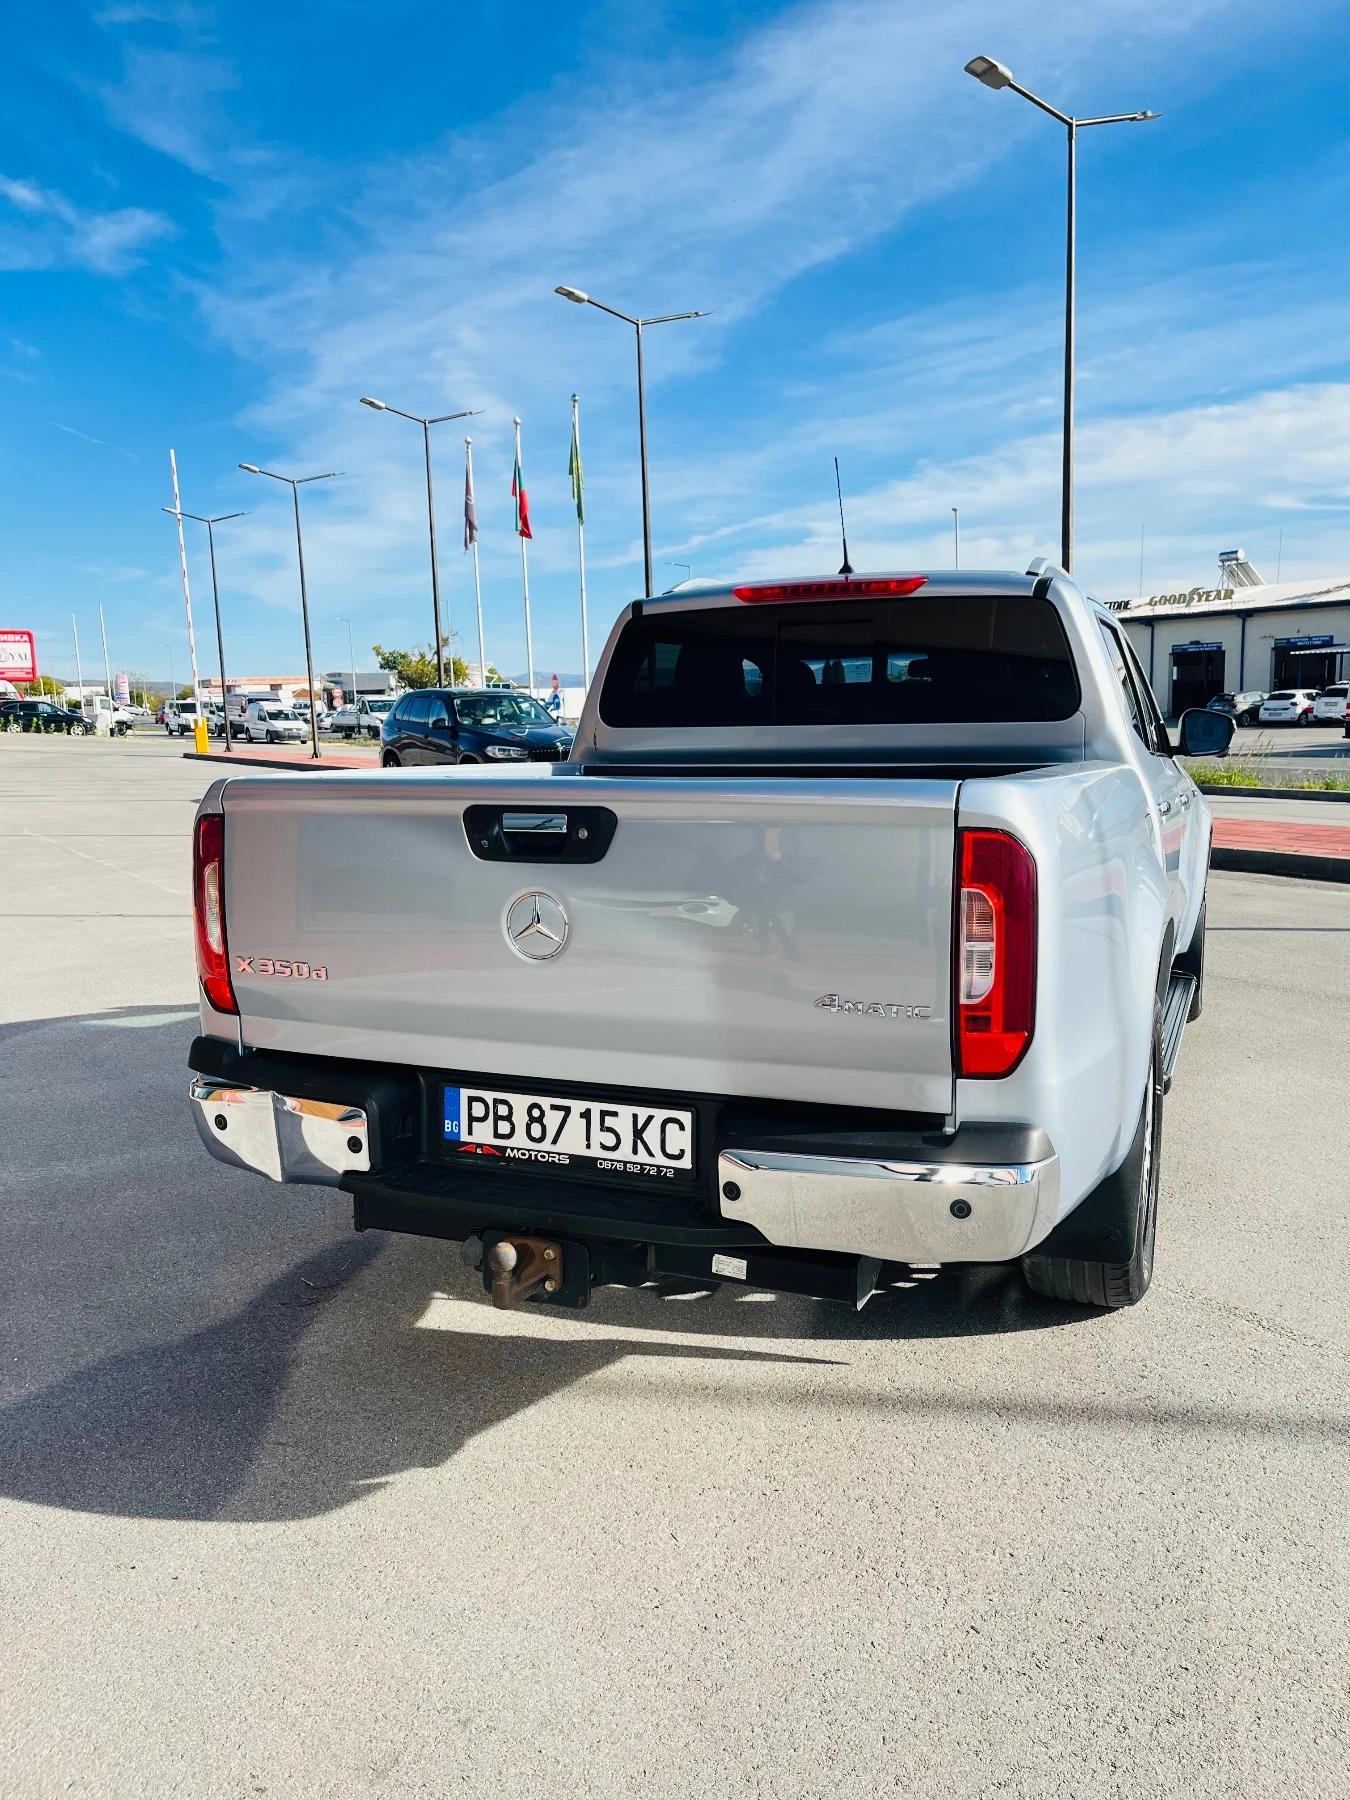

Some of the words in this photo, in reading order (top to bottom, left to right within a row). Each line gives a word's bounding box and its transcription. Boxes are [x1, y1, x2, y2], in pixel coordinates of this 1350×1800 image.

[1148, 587, 1235, 607] GOODYEAR
[813, 993, 931, 1020] 4MATIC
[444, 1119, 459, 1133] BG
[525, 1102, 622, 1153] 8715
[505, 1147, 570, 1164] MOTORS
[597, 1159, 624, 1171] 0876
[626, 1163, 641, 1173] 52
[643, 1165, 658, 1176] 72
[659, 1167, 674, 1178] 72
